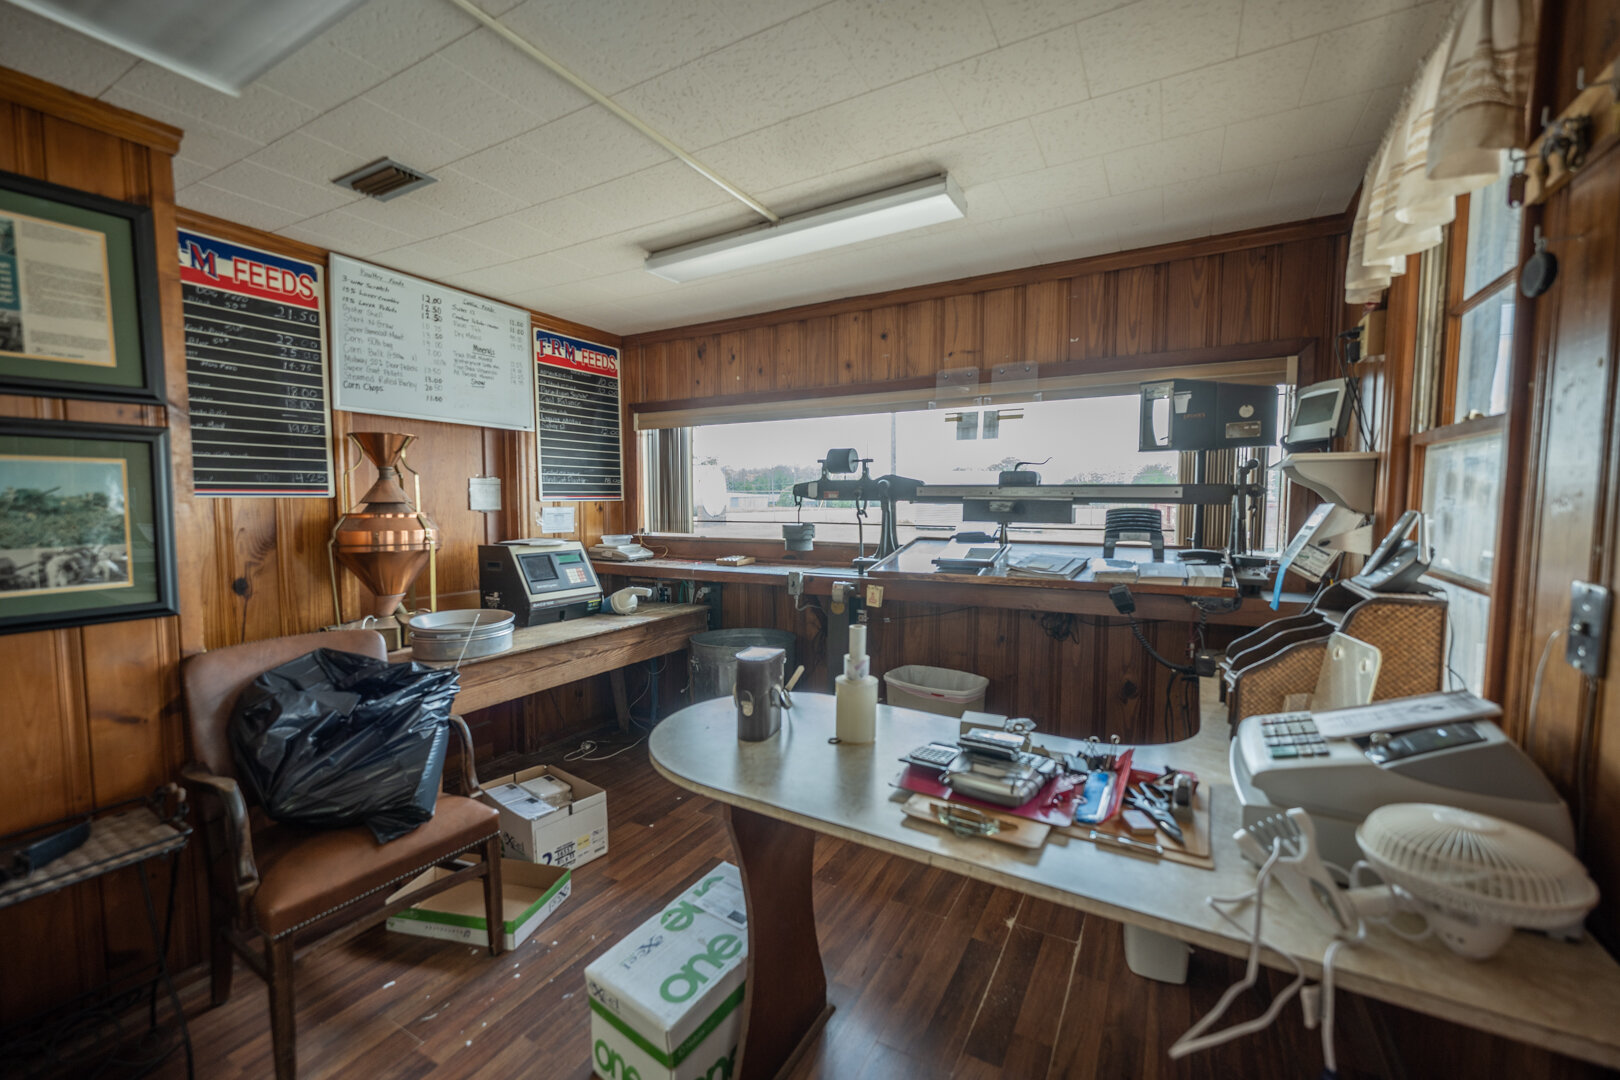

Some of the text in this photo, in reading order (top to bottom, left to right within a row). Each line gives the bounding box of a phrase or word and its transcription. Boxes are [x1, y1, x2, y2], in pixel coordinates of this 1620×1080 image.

[233, 257, 315, 302] FEEDS
[275, 306, 318, 325] 21.50
[581, 347, 617, 373] FEEDS
[342, 380, 361, 389] Corn
[659, 933, 744, 1004] one
